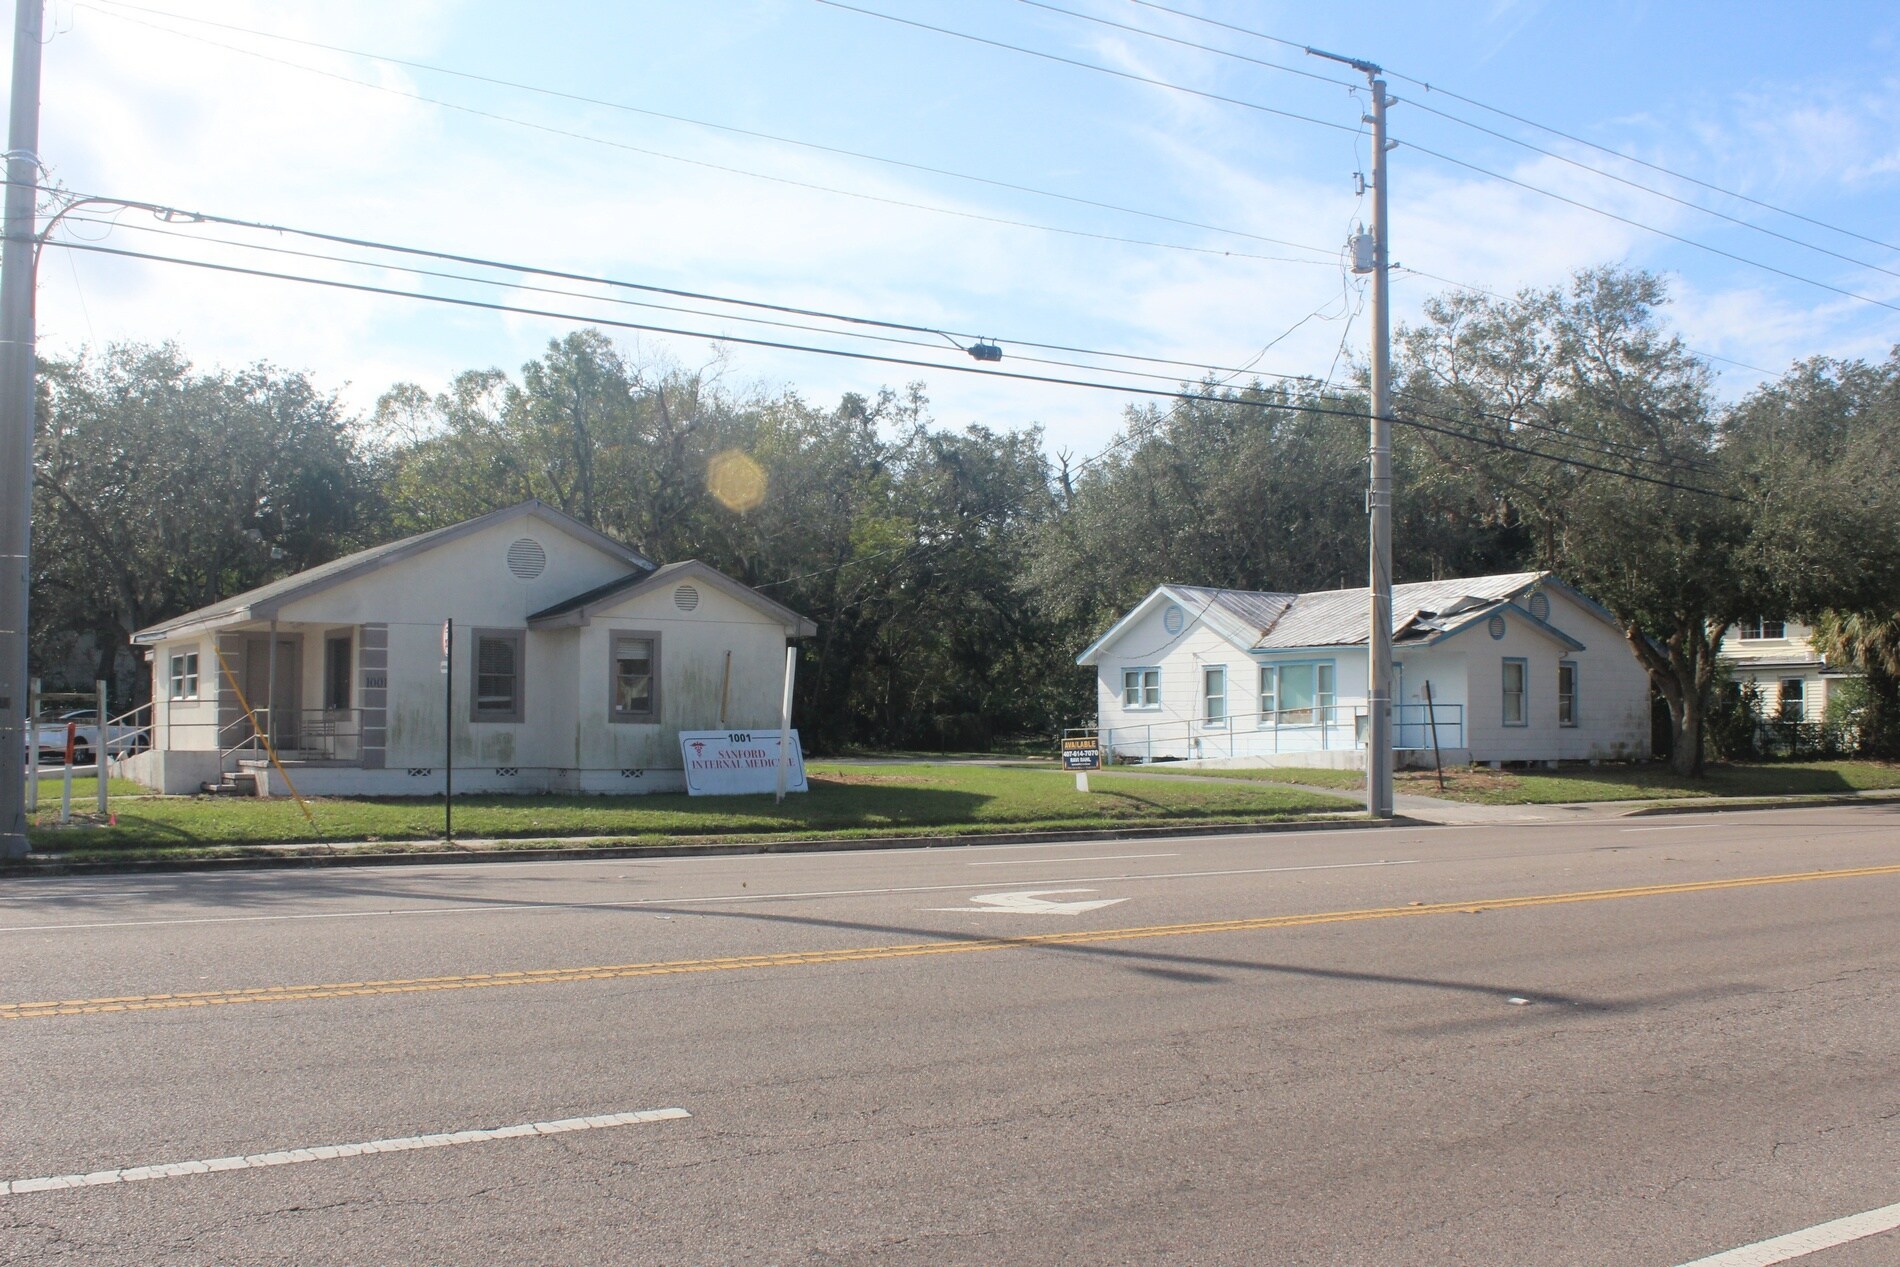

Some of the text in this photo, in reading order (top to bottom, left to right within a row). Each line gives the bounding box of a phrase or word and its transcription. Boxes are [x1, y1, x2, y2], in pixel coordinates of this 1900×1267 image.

[728, 733, 752, 742] 1001
[1064, 740, 1096, 749] AVAILABLE
[718, 749, 766, 759] SANFORD
[692, 758, 796, 769] INTERNAL MEDICE
